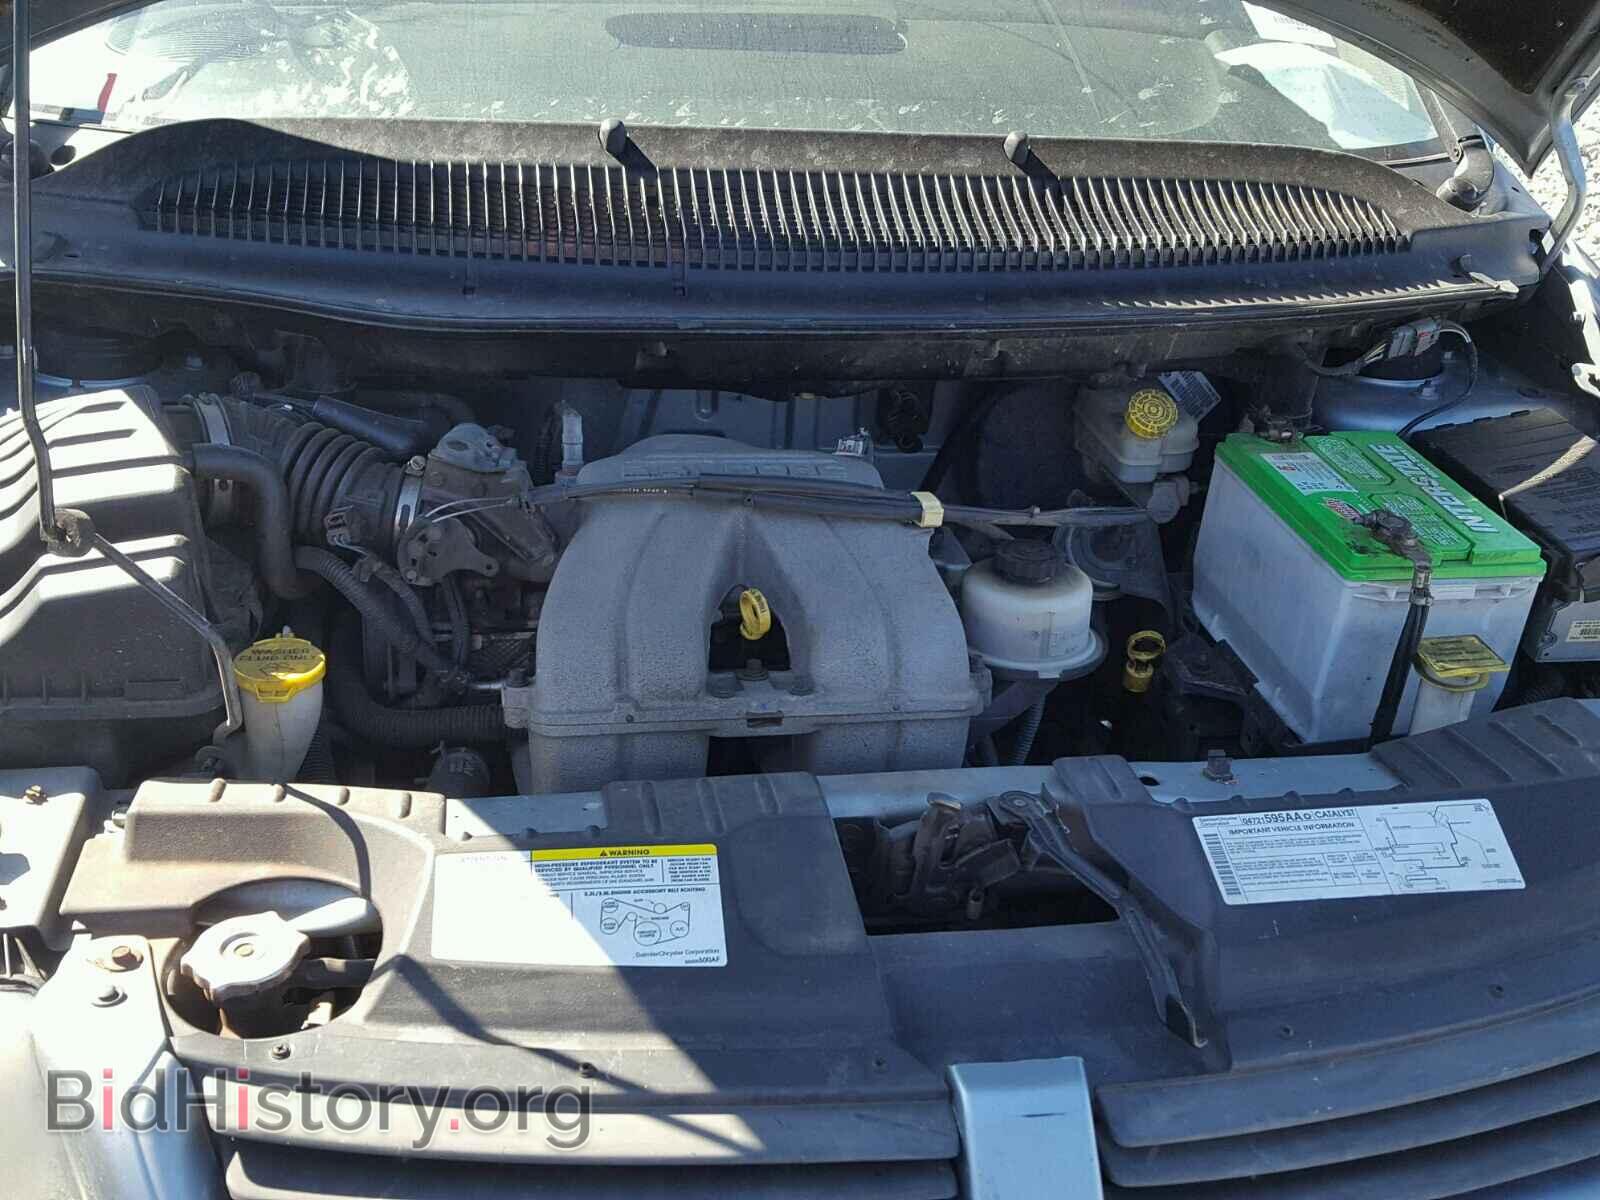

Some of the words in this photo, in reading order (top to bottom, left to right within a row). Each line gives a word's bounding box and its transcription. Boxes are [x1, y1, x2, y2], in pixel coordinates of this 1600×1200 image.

[1368, 443, 1500, 533] INTERSTATE
[1314, 809, 1356, 819] CATALYST
[1228, 827, 1271, 836] IMPORTANT
[1272, 825, 1301, 833] VEHICLE
[1303, 822, 1355, 832] INFORMATION
[609, 849, 650, 857] WARNING
